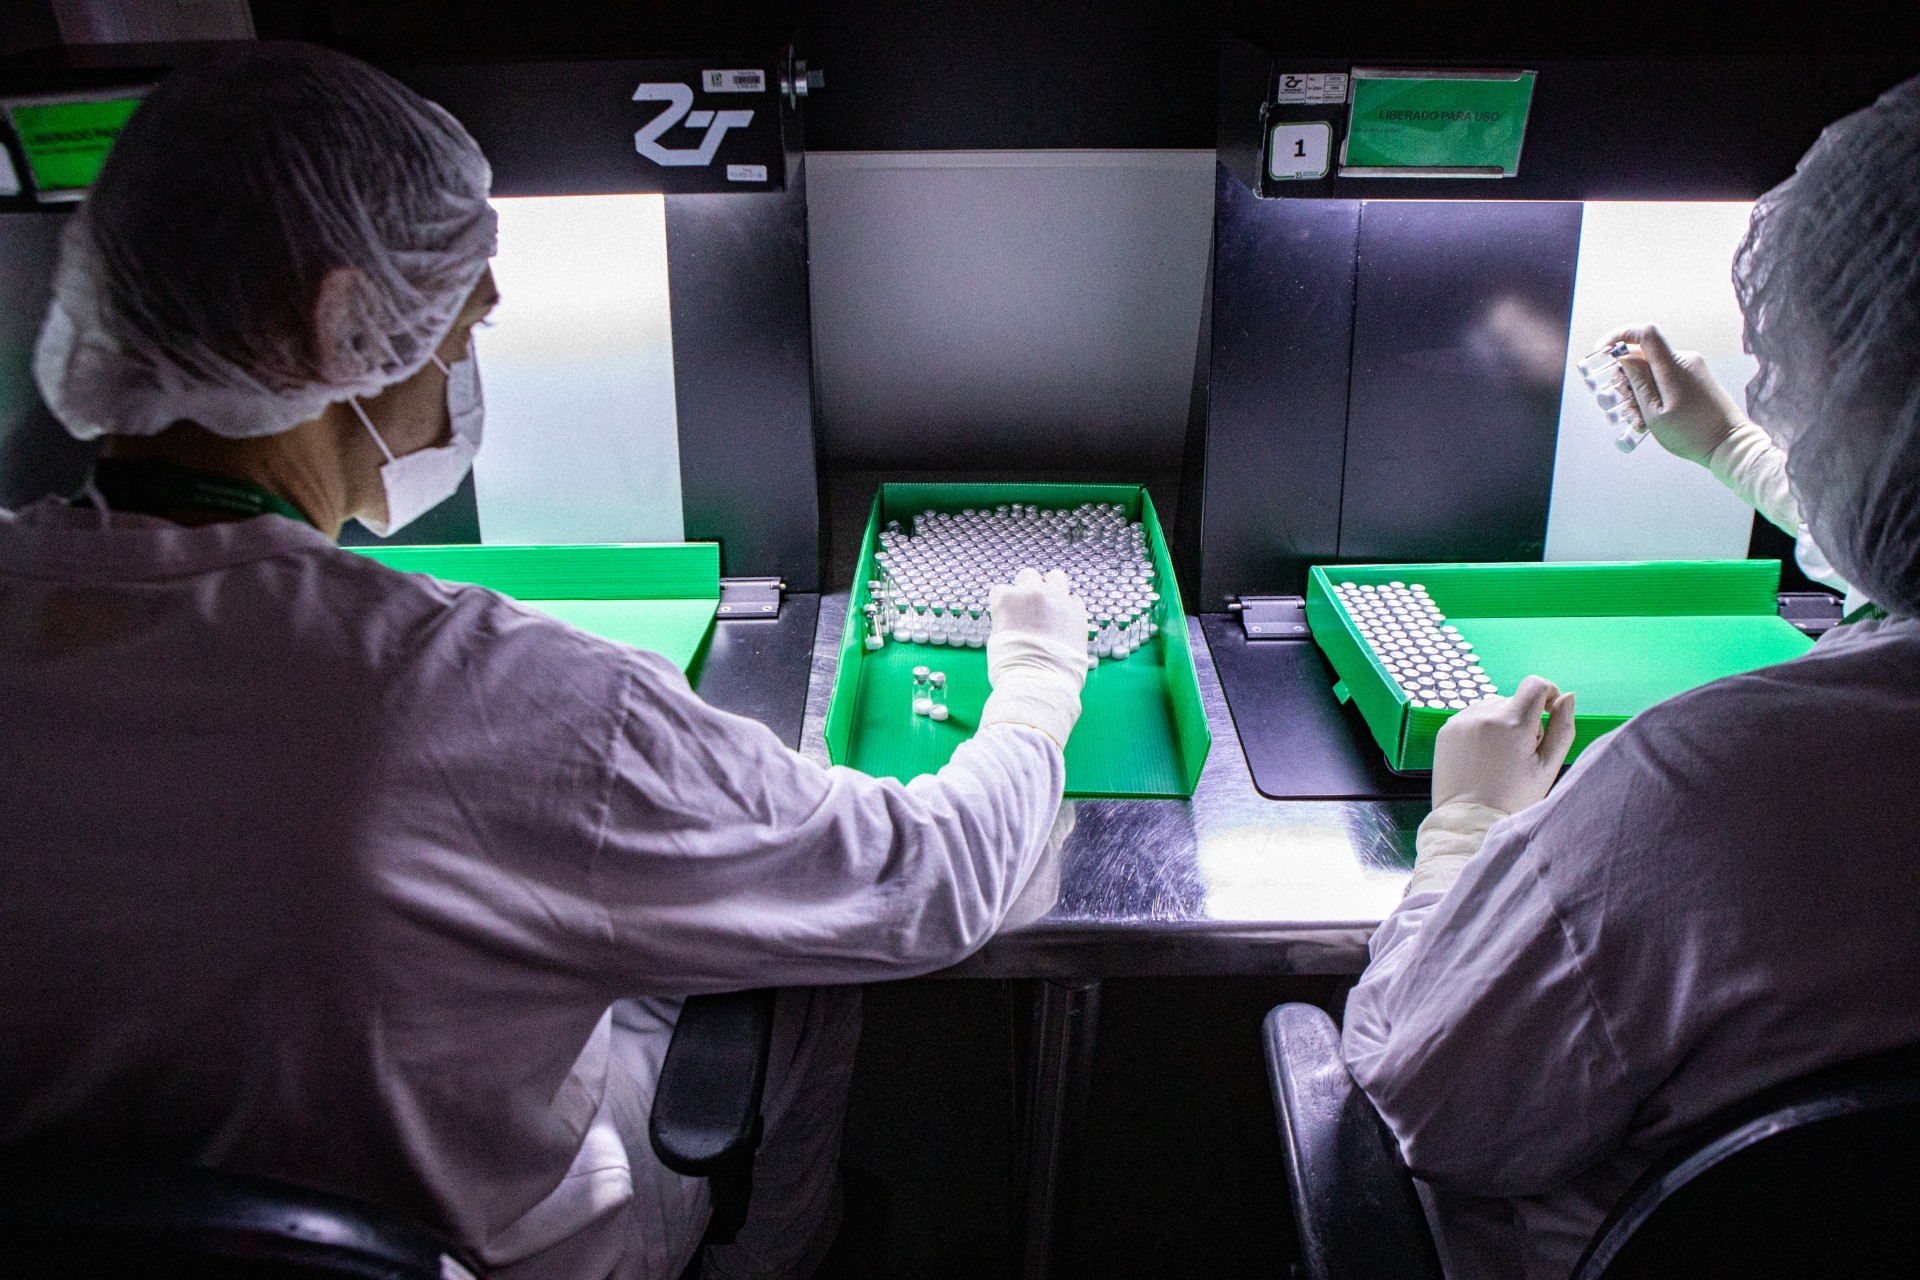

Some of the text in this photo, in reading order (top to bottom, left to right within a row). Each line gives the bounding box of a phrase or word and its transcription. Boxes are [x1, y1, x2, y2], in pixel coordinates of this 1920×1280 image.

[1378, 110, 1500, 122] LIBERADO PARA USO
[1294, 139, 1306, 157] 1
